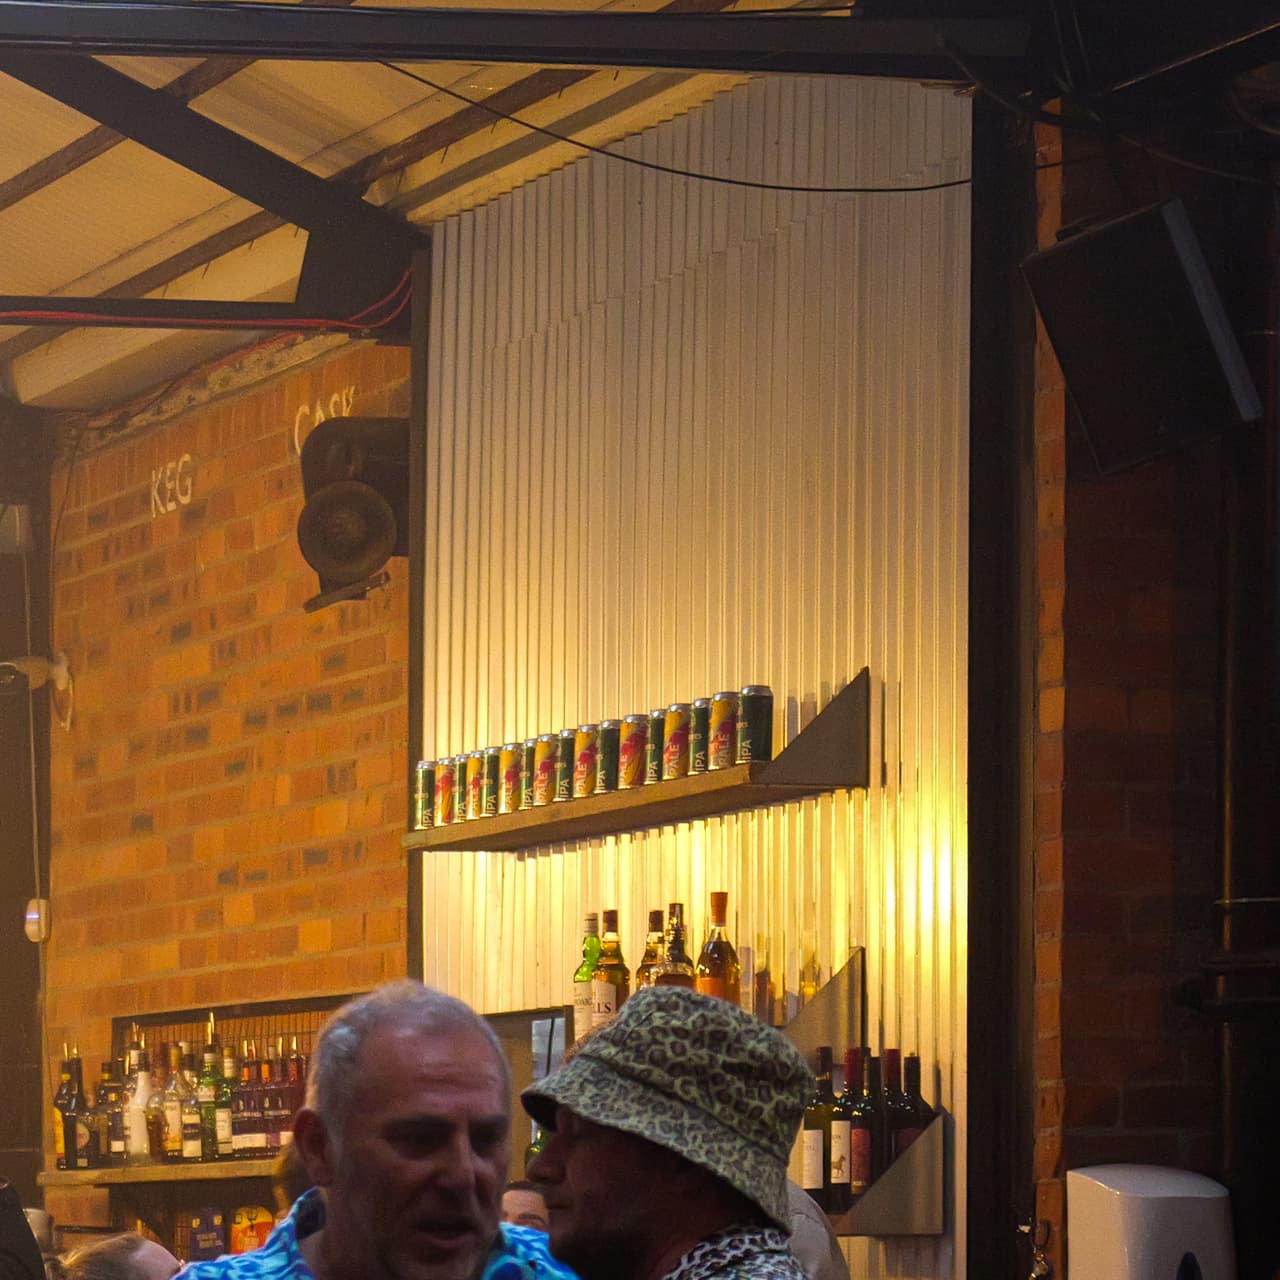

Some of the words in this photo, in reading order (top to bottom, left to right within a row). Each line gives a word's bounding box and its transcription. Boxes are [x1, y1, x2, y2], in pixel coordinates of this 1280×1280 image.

[151, 453, 194, 519] KEG
[695, 751, 706, 771] IPA
[741, 740, 753, 762] IPA
[596, 770, 607, 791] IPA
[648, 760, 658, 782] IPA
[559, 778, 570, 798] IPA
[486, 794, 497, 816] IPA
[422, 808, 433, 829] IPA
